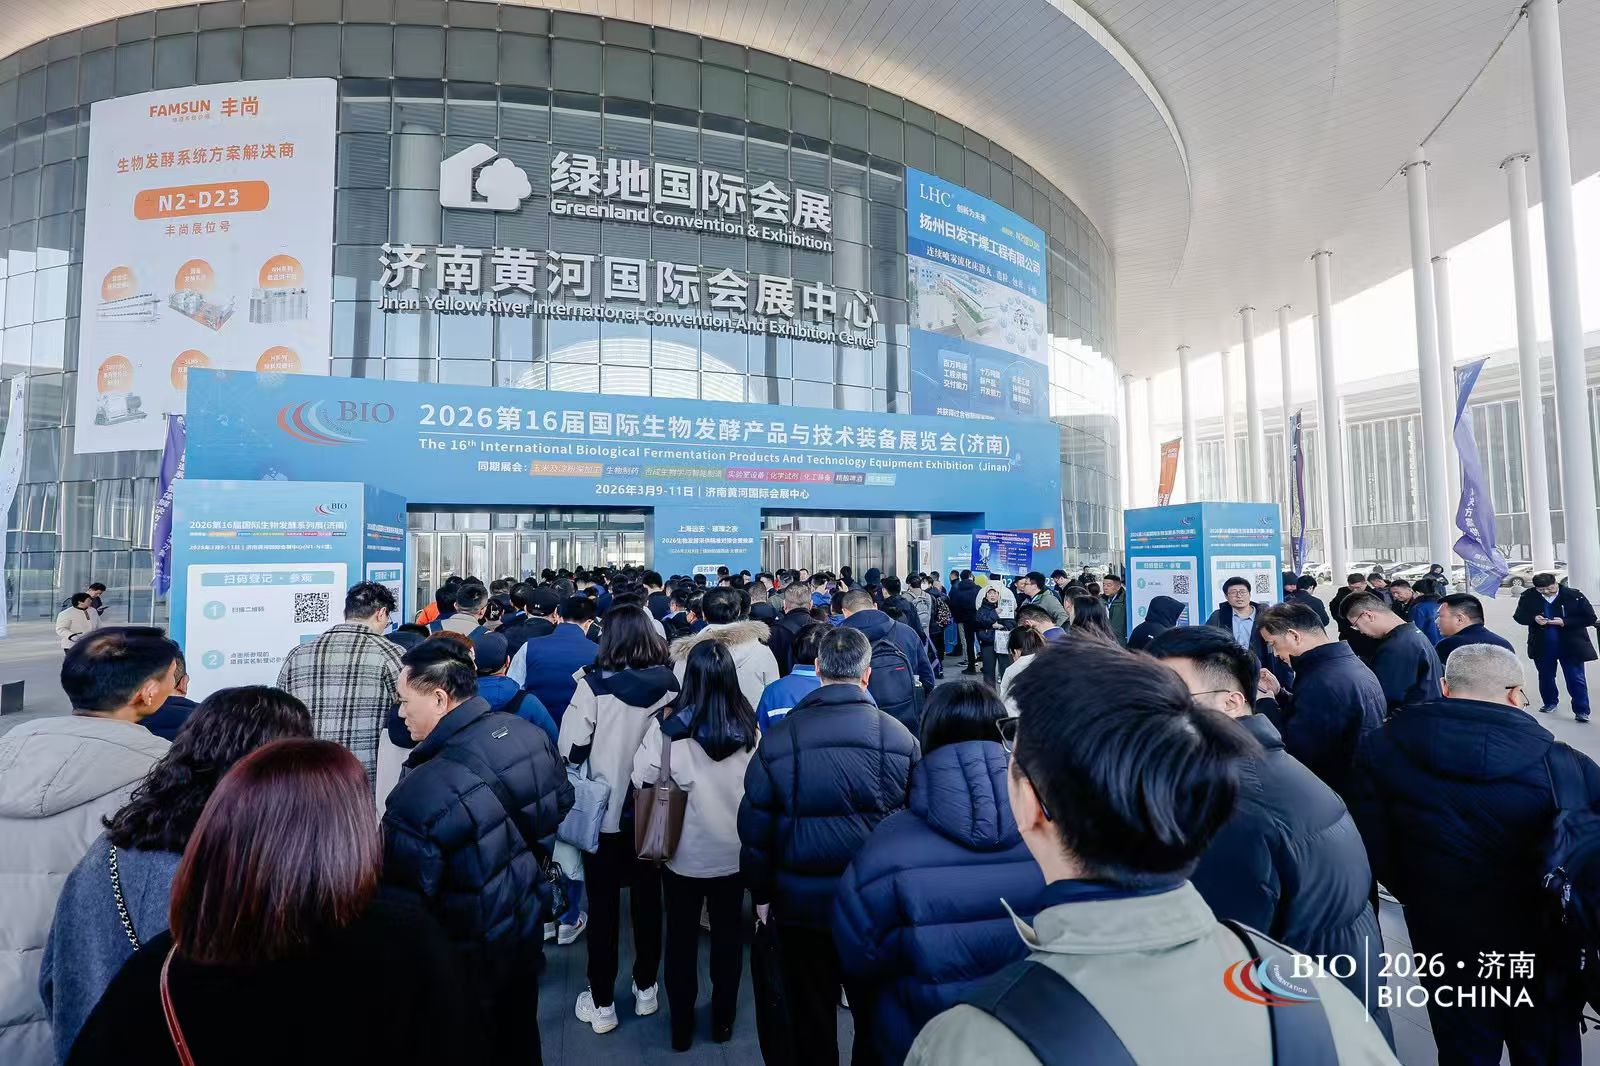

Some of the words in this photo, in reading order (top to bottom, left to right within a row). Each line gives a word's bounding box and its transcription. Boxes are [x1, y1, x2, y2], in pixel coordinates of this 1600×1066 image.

[149, 99, 211, 118] FAMSUN
[220, 95, 260, 117] 丰尚
[116, 142, 295, 174] 生物发酵系统方案解决商
[158, 188, 240, 213] N2-D23
[550, 150, 832, 233] 绿地国际会展
[919, 183, 951, 208] LHC
[165, 220, 231, 238] 丰尚展位号
[550, 199, 650, 222] Greenland
[652, 209, 744, 236] Convention
[746, 223, 760, 238] &
[762, 228, 832, 252] Exhibition
[919, 212, 1041, 276] 扬州日发干燥工程有限公司
[378, 242, 879, 329] 济南黄河国际会展中心
[376, 294, 420, 313] Jinan
[425, 296, 481, 314] Yellow
[486, 299, 529, 316] River
[533, 300, 640, 320] International
[644, 308, 731, 328] Convention
[738, 316, 765, 332] And
[769, 317, 836, 340] Exhibition
[839, 331, 880, 350] Center
[337, 400, 395, 424] BIO
[419, 438, 446, 450] The
[480, 441, 572, 456] International
[576, 444, 640, 460] Biological
[643, 447, 729, 462] Fermentation
[730, 451, 780, 464] Products
[783, 453, 803, 465] And
[806, 454, 867, 469] Technology
[869, 458, 923, 473] Equipment
[926, 460, 974, 471] Exhibition
[595, 483, 694, 498] 2026年3月9-11日
[705, 486, 810, 501] 济南黄河国际会展中心
[331, 502, 348, 510] BIO
[212, 605, 218, 617] 1
[208, 654, 217, 666] 2
